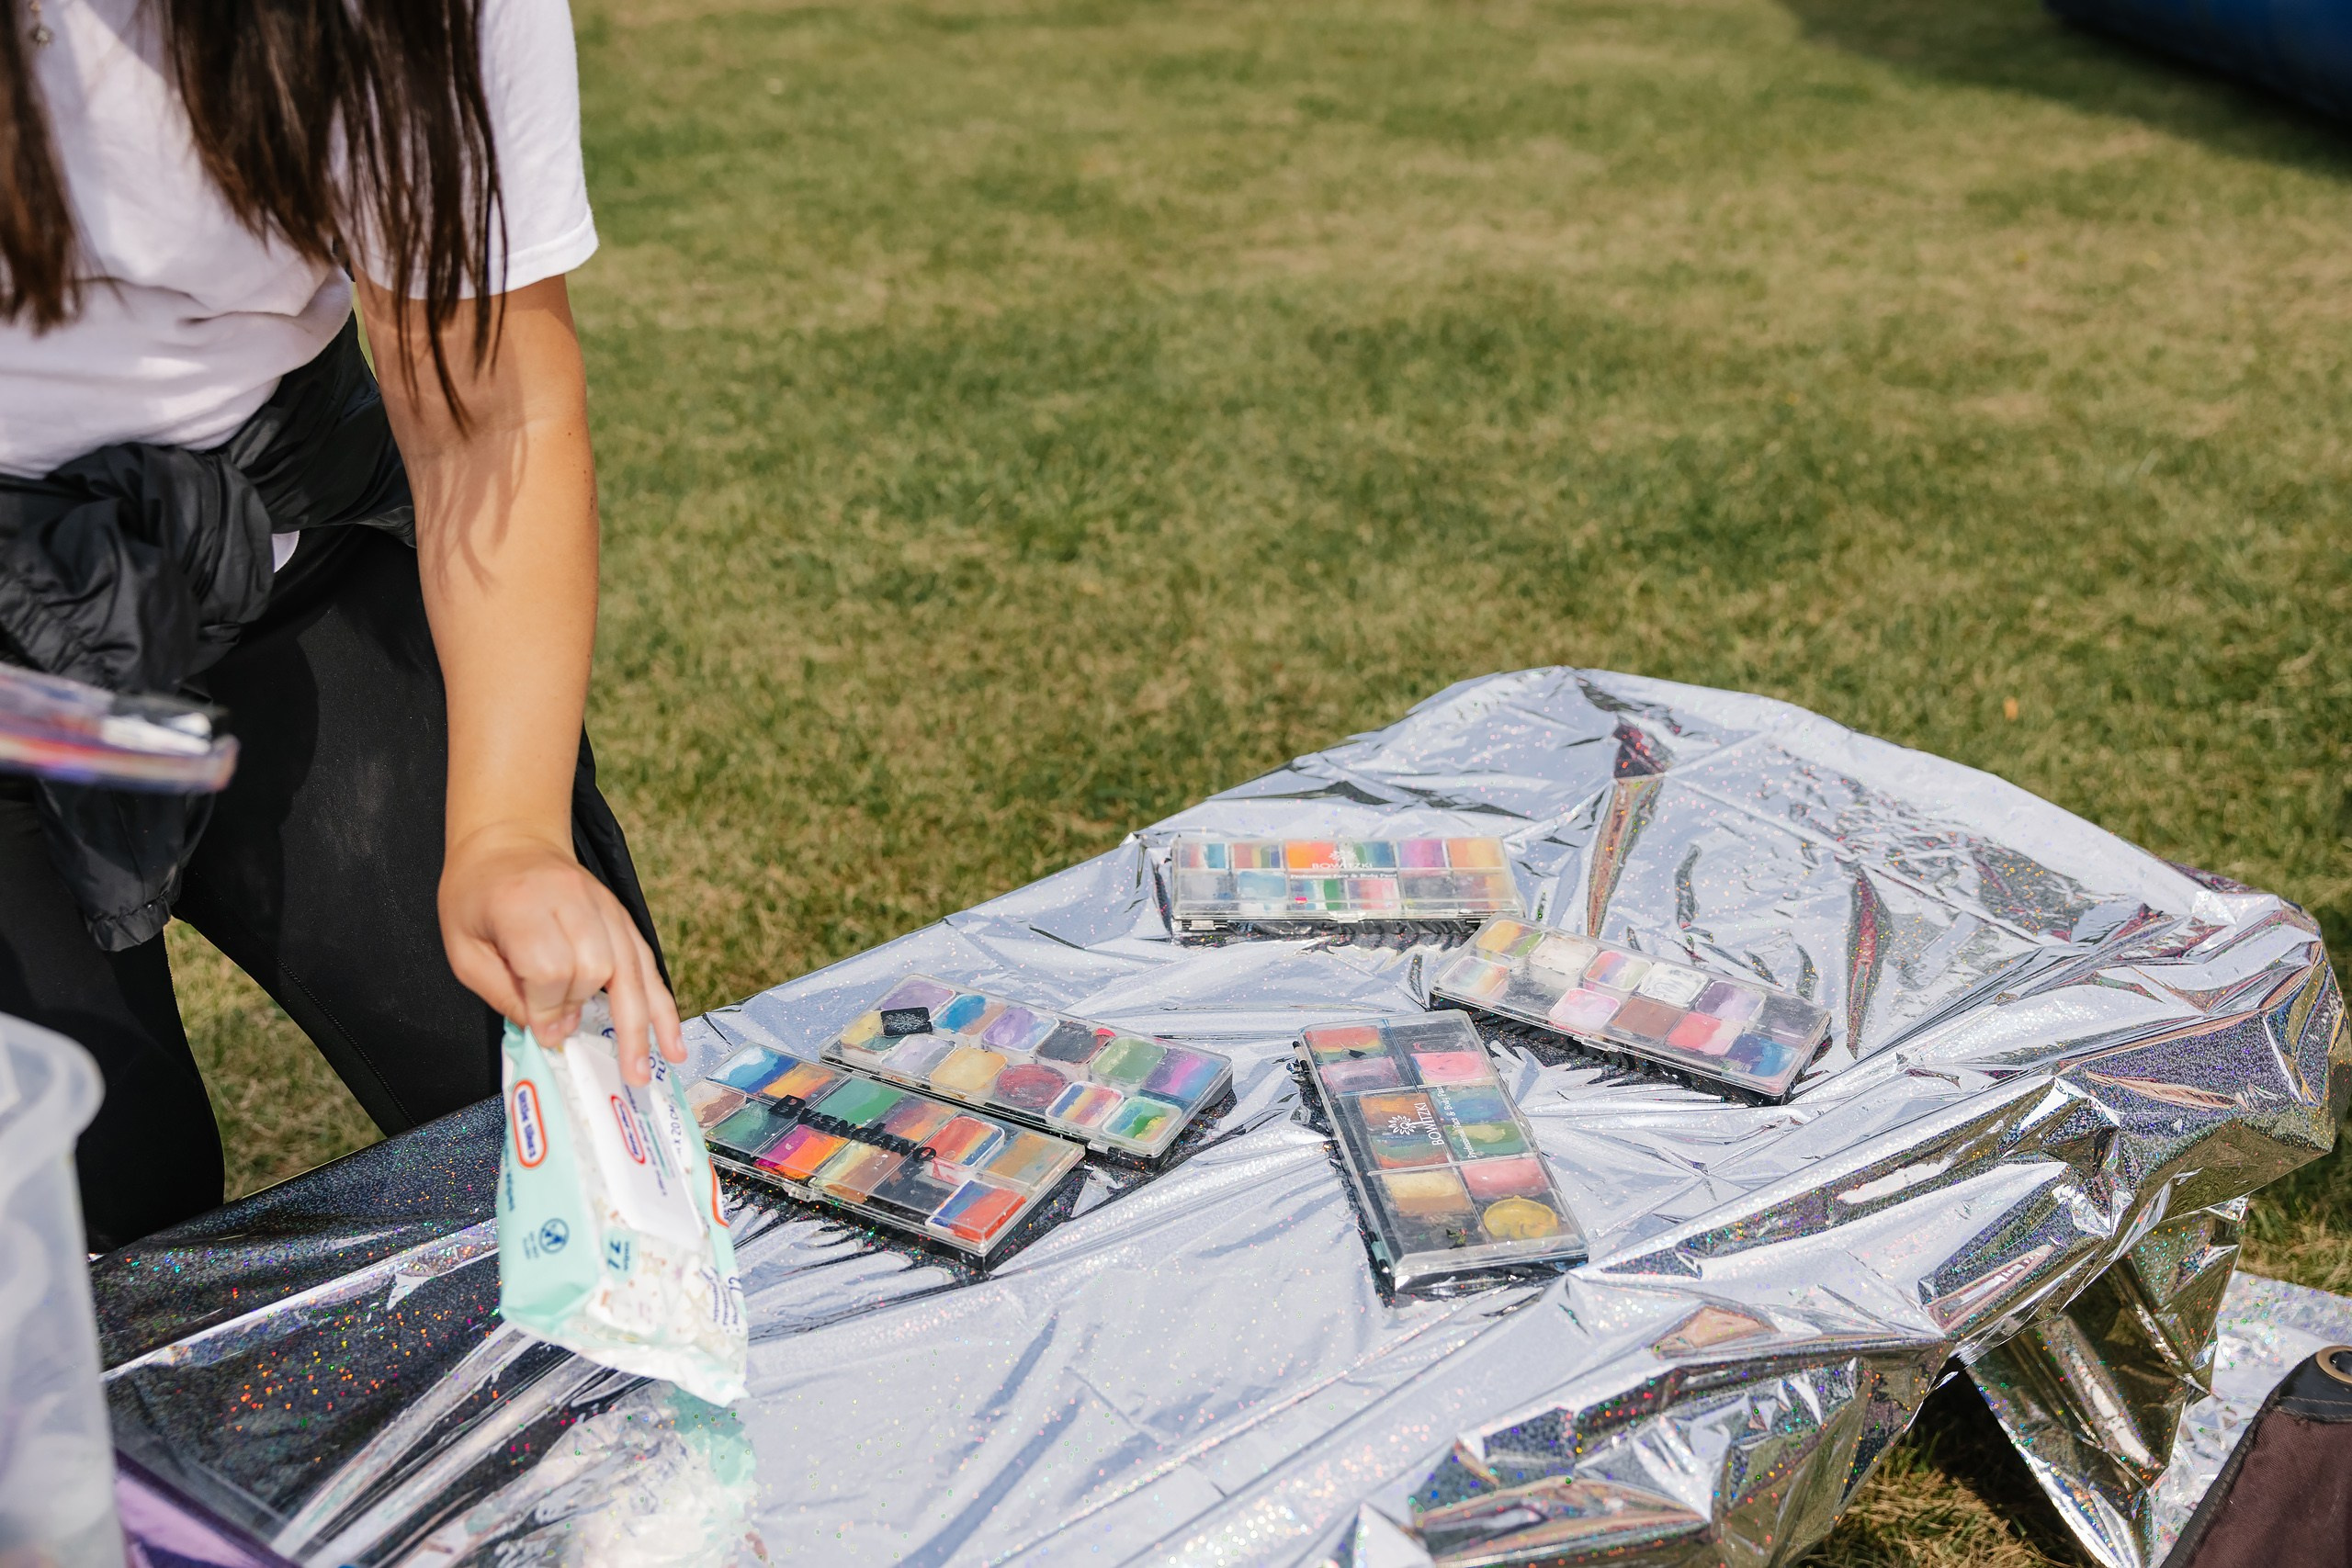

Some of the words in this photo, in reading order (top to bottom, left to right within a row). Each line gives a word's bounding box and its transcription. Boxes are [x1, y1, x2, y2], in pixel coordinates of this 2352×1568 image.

[1441, 1097, 1453, 1111] Body
[1413, 1101, 1445, 1145] BOWITZKI
[1451, 1117, 1463, 1129] Face
